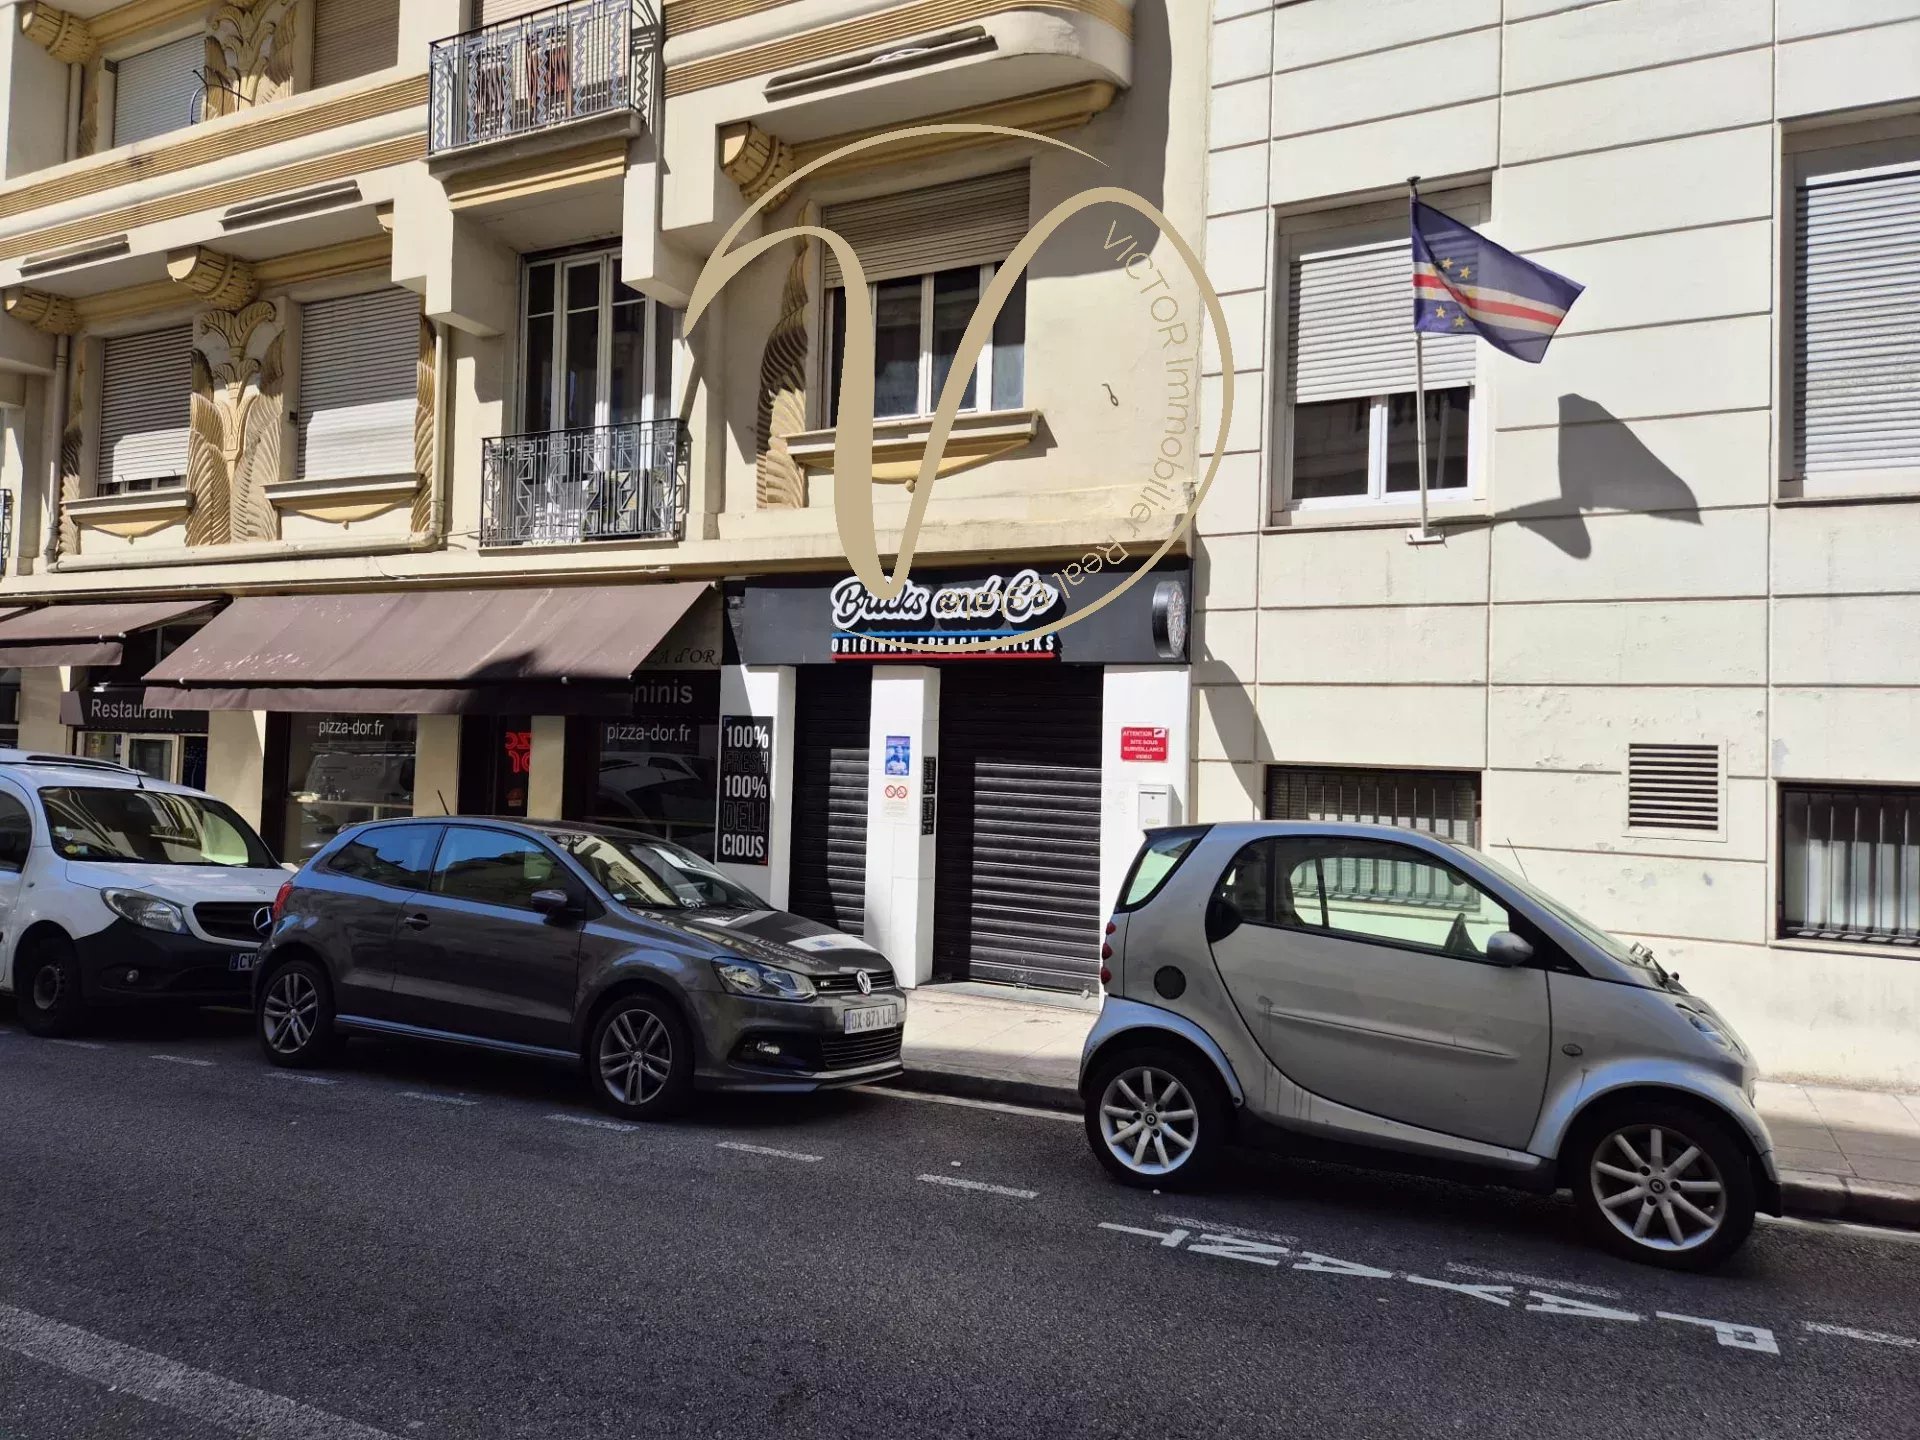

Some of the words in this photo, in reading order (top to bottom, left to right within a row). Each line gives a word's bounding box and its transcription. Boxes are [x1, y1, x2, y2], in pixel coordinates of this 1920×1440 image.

[91, 698, 174, 719] Restaurant
[318, 718, 385, 737] pizza-dor.fr
[606, 722, 692, 744] pizza-dor.fr
[726, 725, 769, 749] 100%
[723, 751, 769, 774] FRESH
[724, 775, 767, 799] 100%
[722, 800, 766, 833] DELI
[722, 833, 765, 858] CIOUS
[1097, 1221, 1780, 1356] PAYANT
